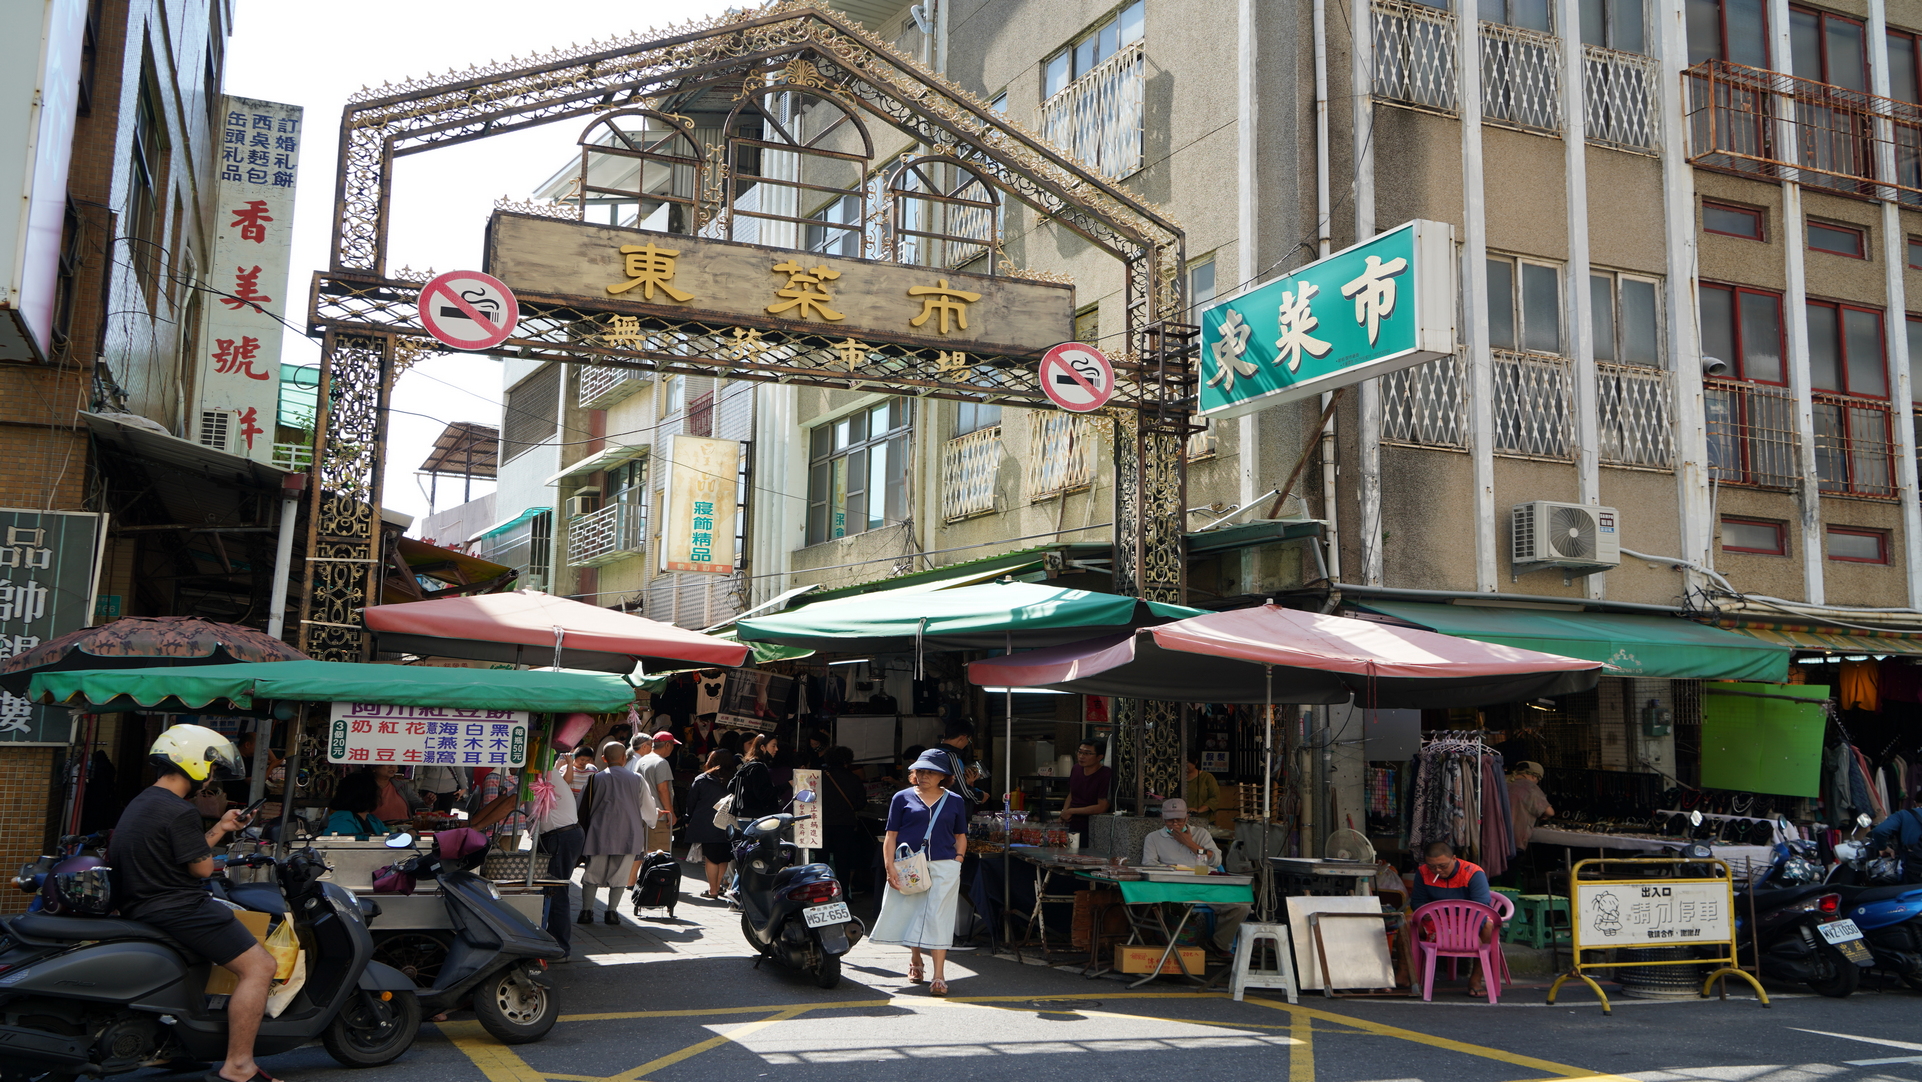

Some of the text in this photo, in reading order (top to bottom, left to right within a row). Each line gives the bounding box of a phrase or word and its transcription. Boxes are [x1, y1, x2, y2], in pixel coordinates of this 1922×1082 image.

[606, 242, 982, 334] 東菜市
[1205, 255, 1409, 394] 東菜市
[690, 501, 714, 562] 寢飾精品
[332, 721, 345, 756] 3個20元
[1633, 900, 1718, 929] 請勿停車
[1641, 887, 1671, 897] 出入口
